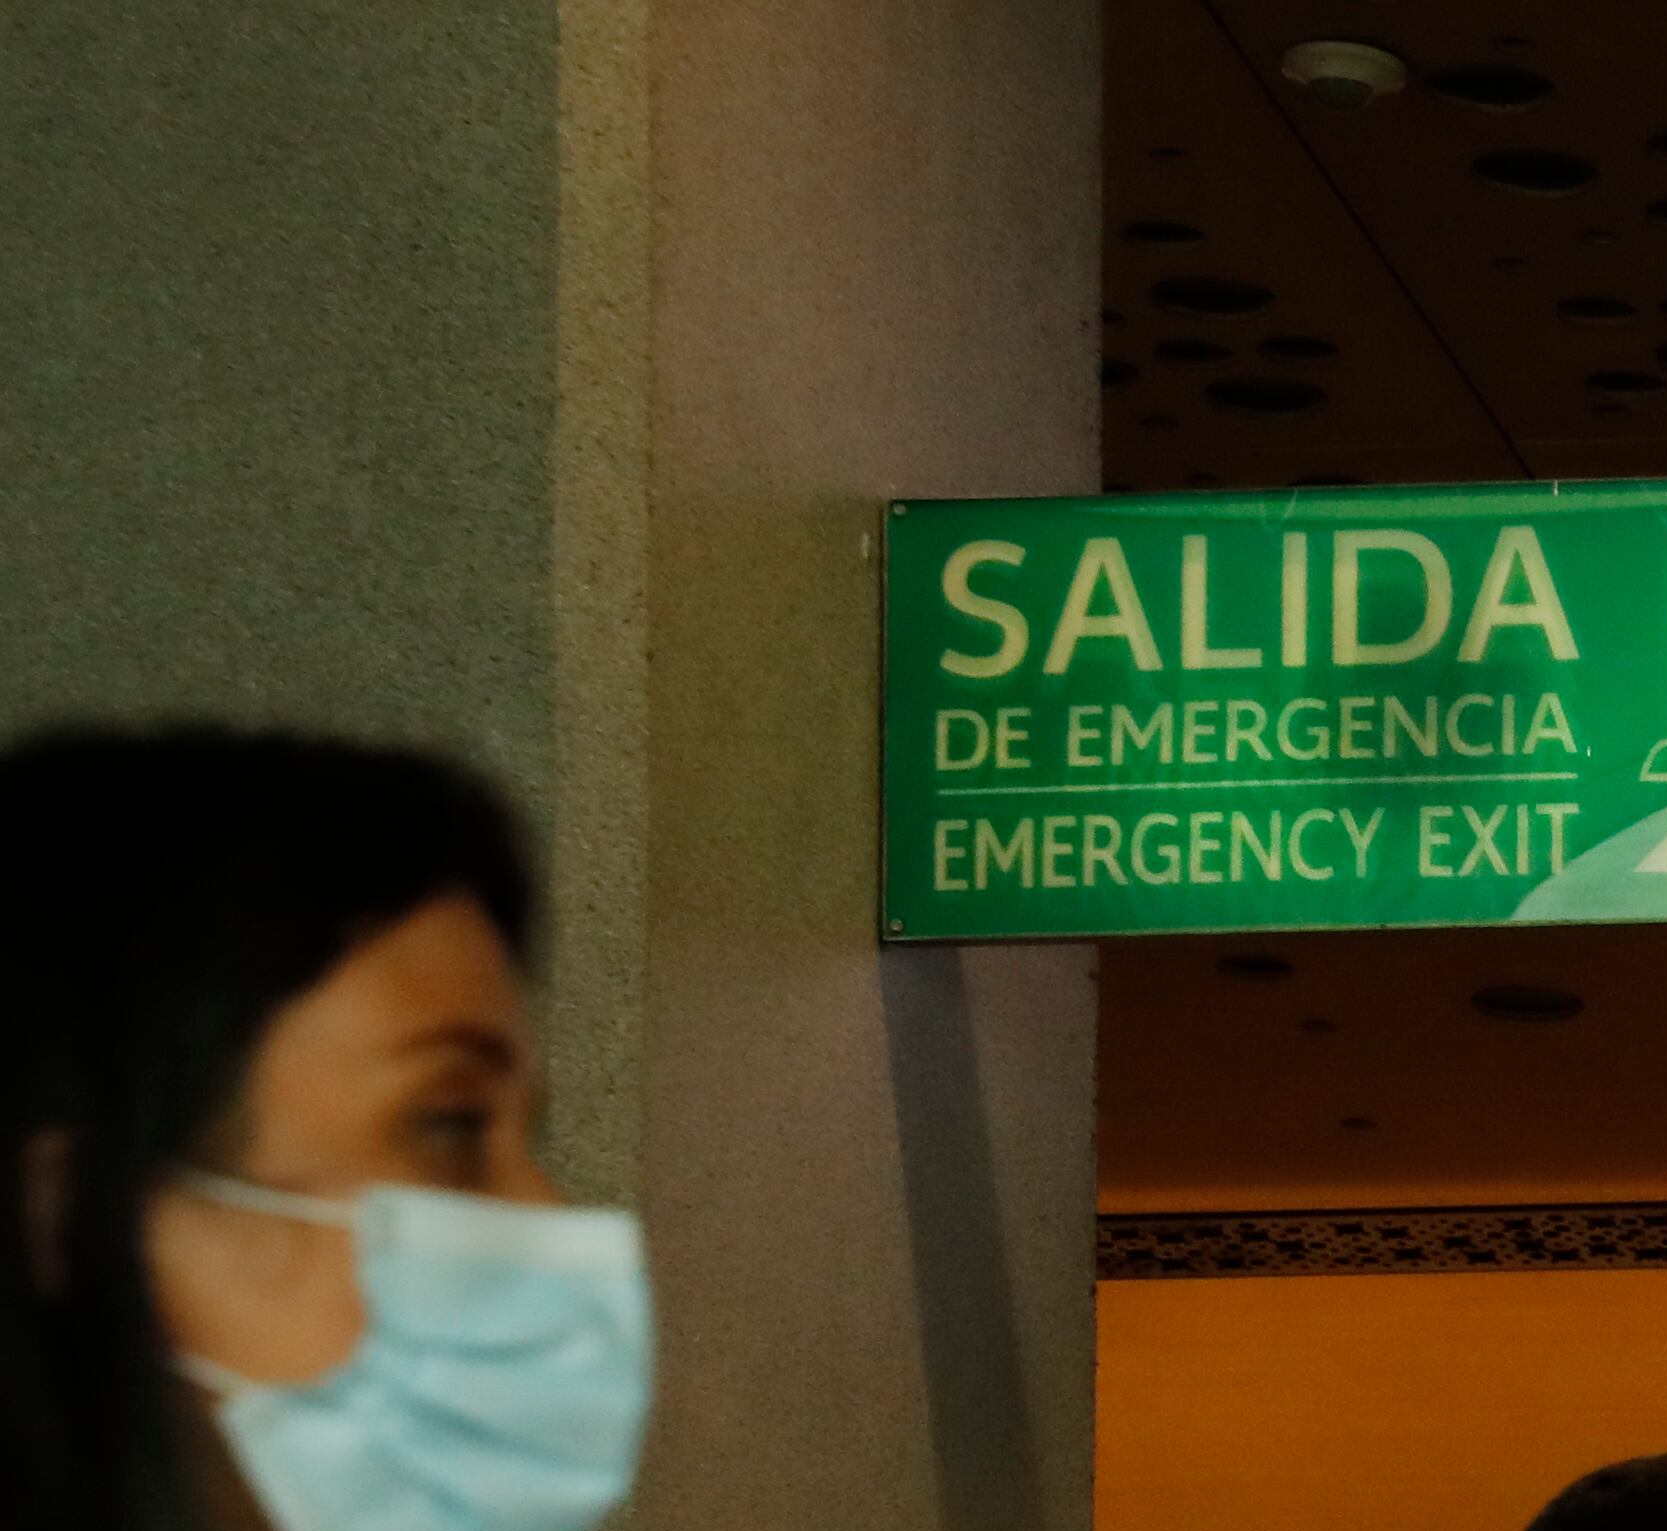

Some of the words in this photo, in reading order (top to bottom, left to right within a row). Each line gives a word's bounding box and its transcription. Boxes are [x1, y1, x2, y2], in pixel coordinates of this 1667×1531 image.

[939, 525, 1581, 679] SALIDA
[935, 708, 1034, 773] DE
[1066, 692, 1579, 770] EMERGENCIA
[933, 806, 1385, 893] EMERGENCY
[1419, 802, 1580, 878] EXIT
